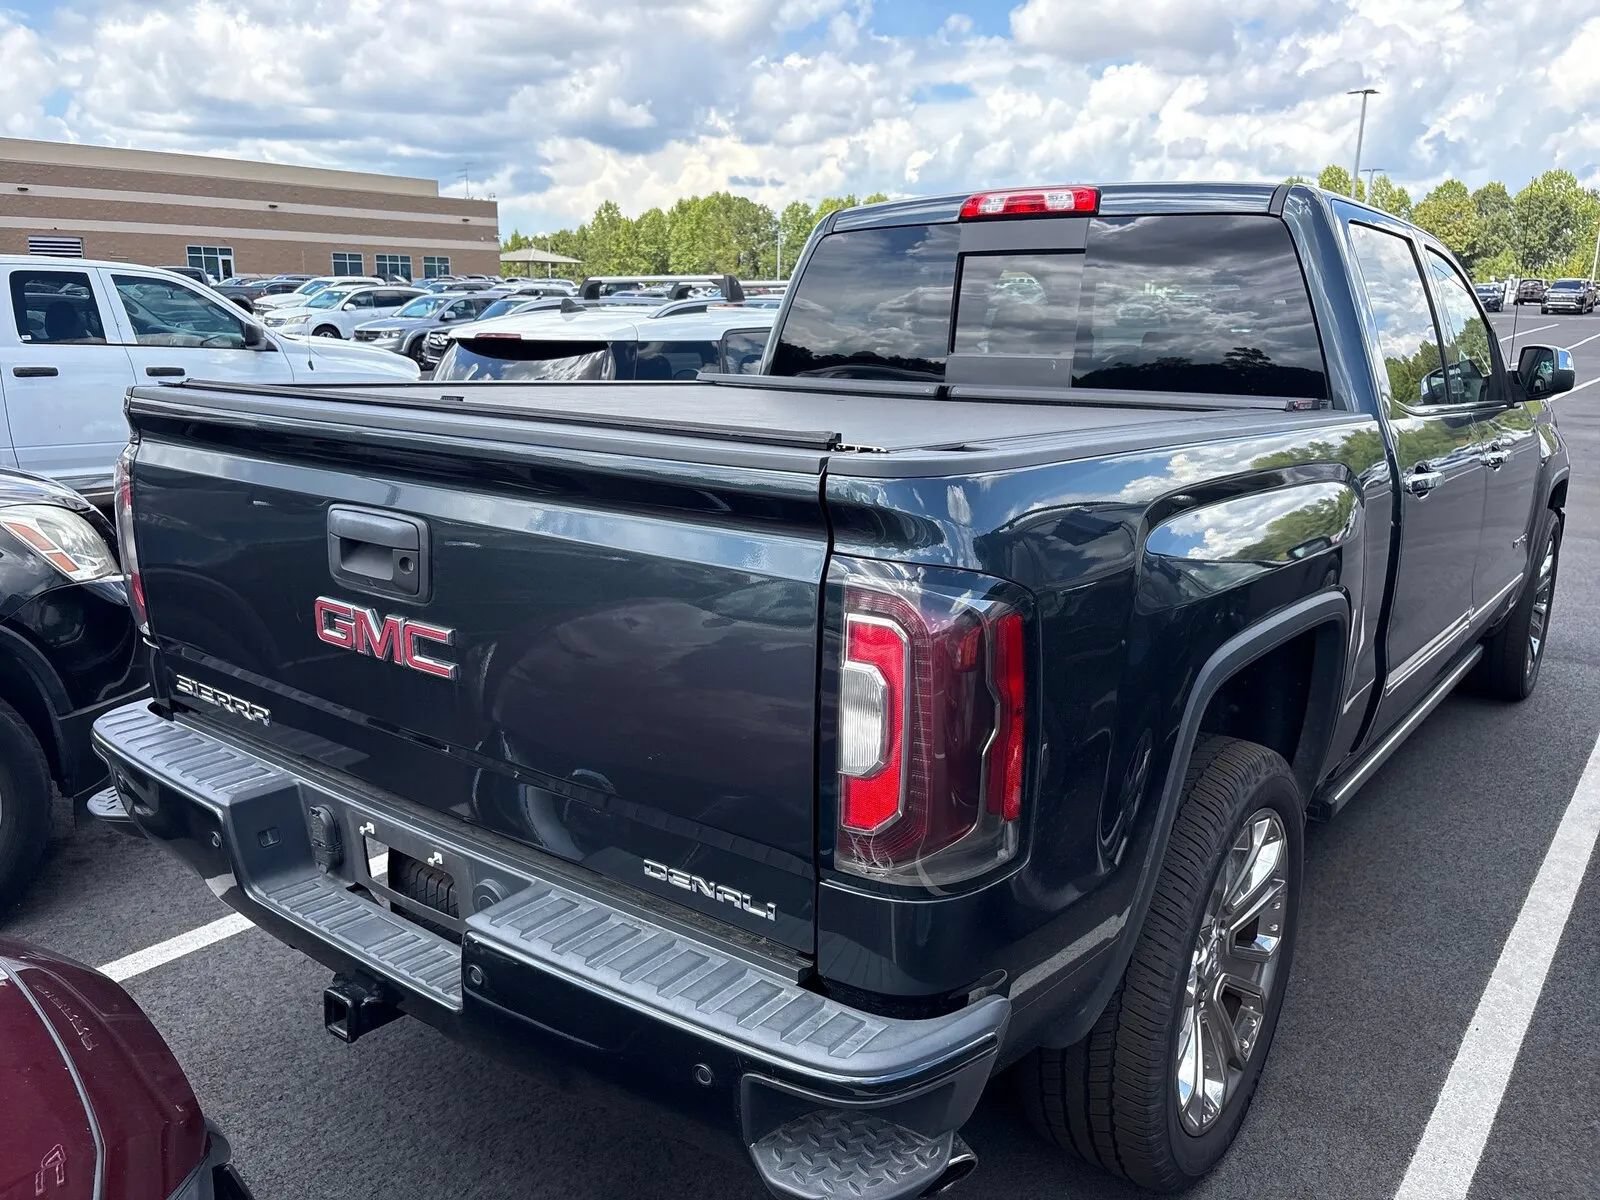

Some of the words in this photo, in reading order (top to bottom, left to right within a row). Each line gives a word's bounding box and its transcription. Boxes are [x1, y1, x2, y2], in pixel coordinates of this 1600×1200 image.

[314, 597, 456, 680] GMC
[175, 674, 271, 728] SIERRA
[643, 859, 777, 921] DENALI
